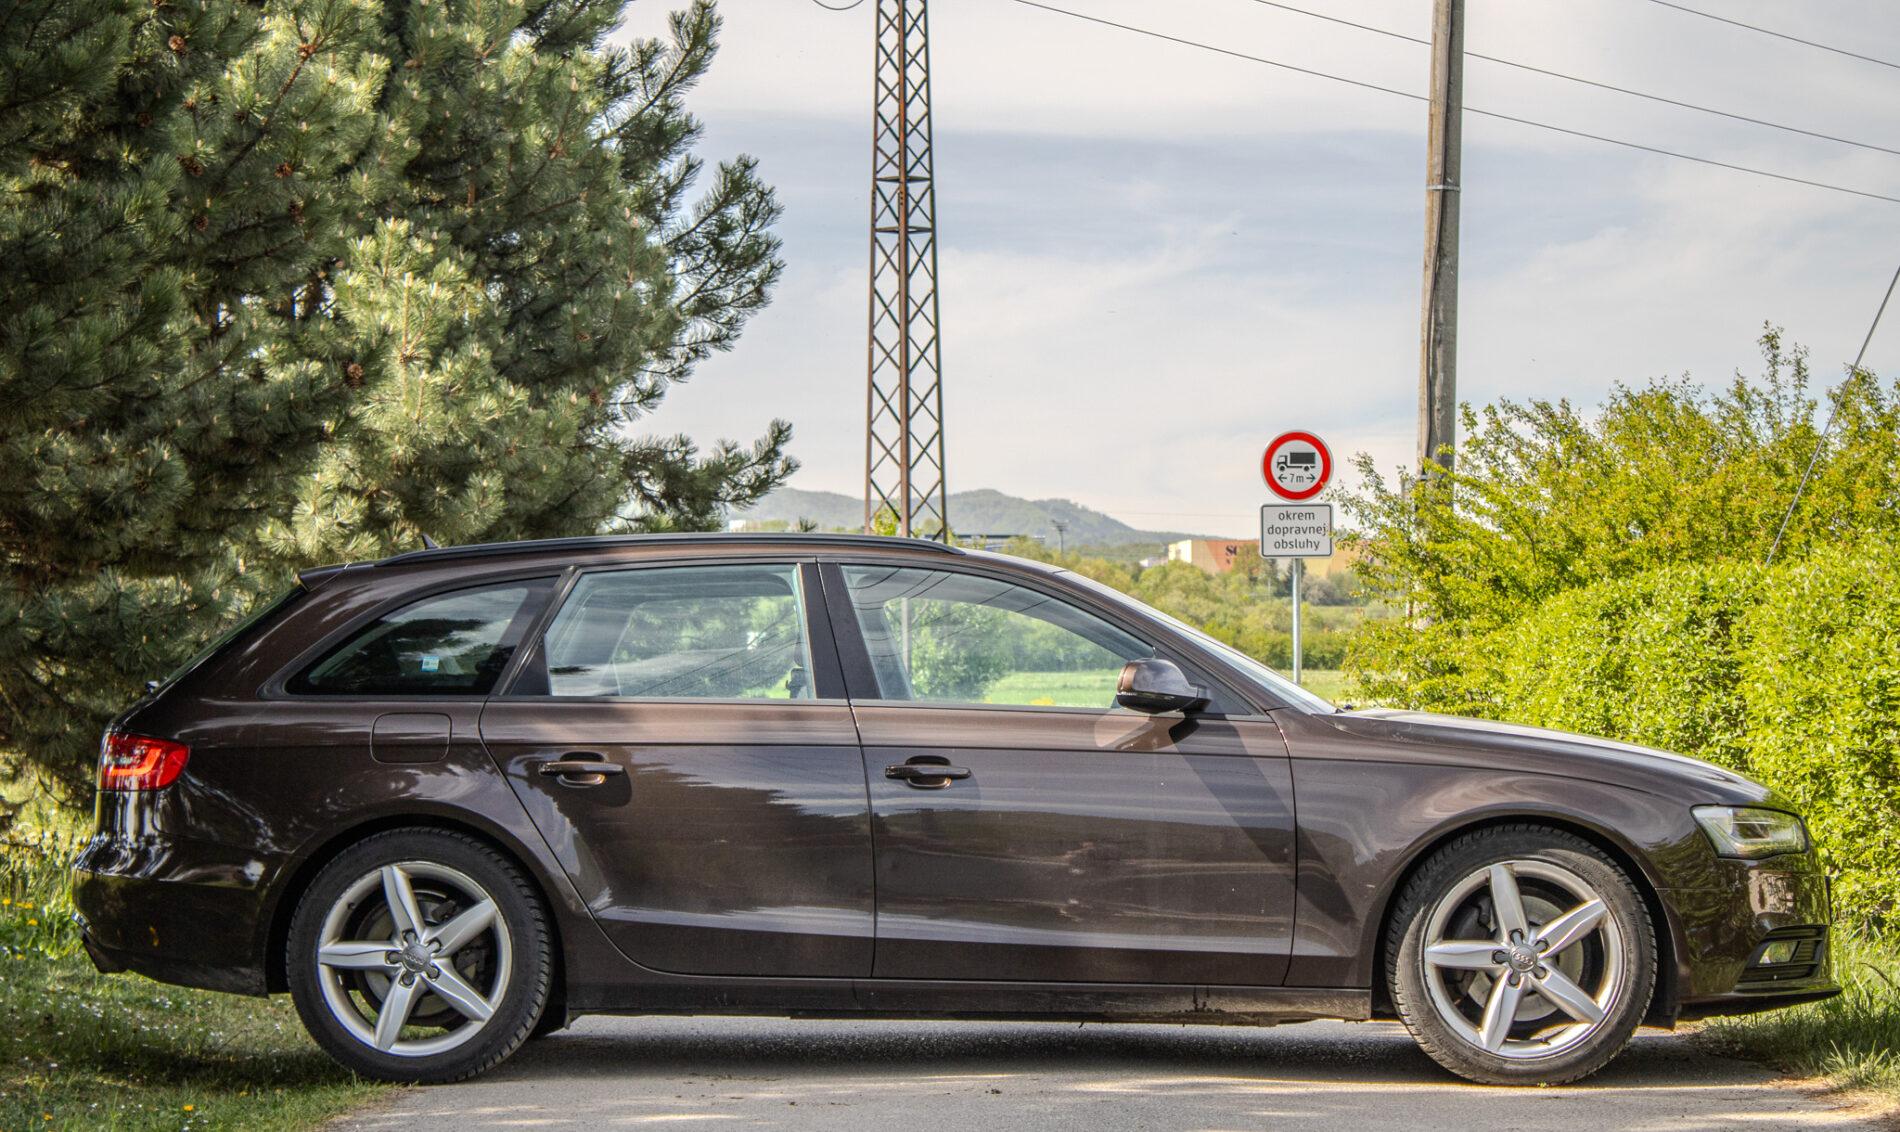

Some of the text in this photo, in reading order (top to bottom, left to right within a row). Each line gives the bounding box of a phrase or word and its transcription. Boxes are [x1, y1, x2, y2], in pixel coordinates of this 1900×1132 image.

[1278, 510, 1315, 521] okrem
[1267, 523, 1326, 536] dopravnej
[1273, 539, 1320, 551] obsluhy
